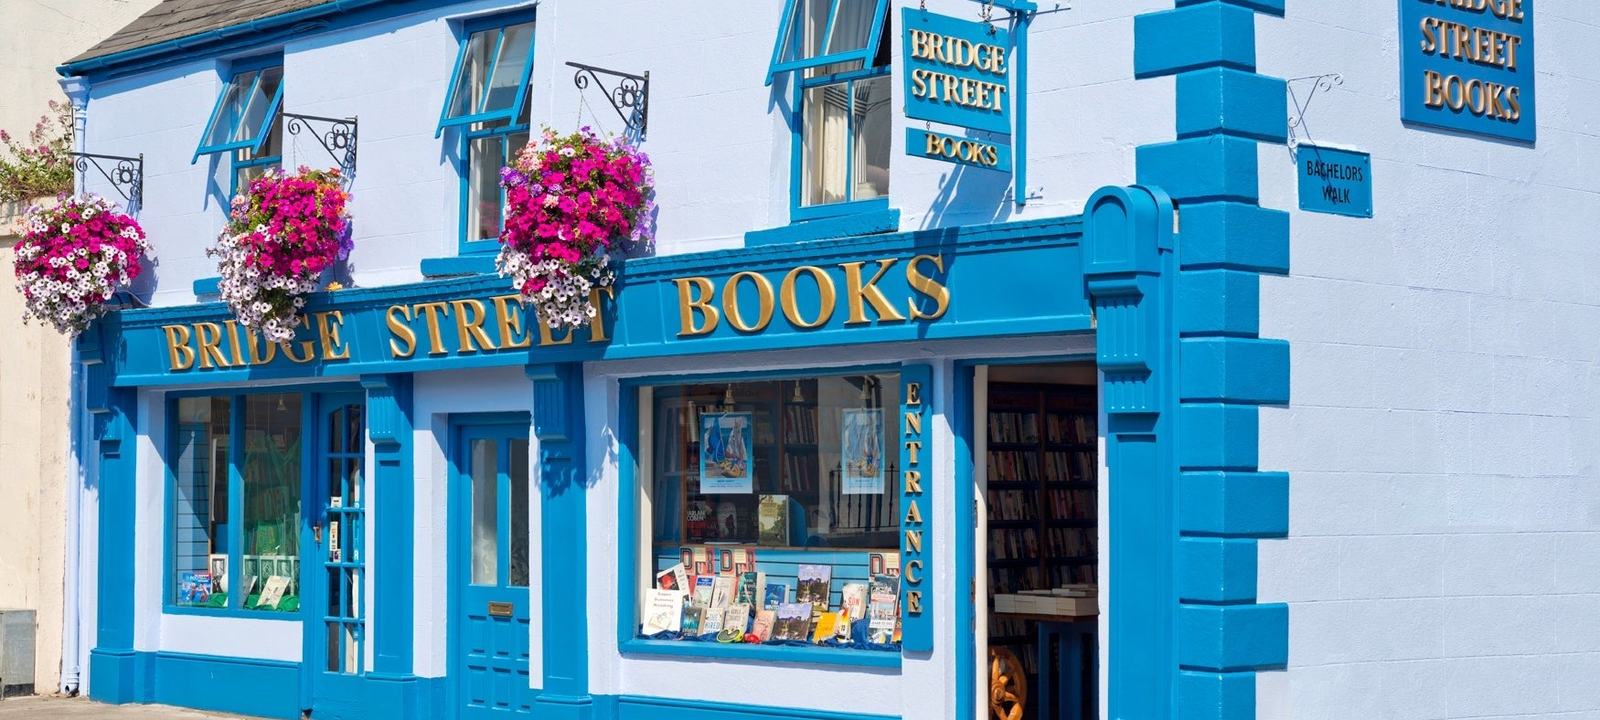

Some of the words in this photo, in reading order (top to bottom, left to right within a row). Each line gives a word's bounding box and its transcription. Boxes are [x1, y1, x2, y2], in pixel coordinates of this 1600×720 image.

[909, 28, 1007, 75] BRIDGE
[1420, 16, 1522, 69] STREET
[911, 68, 1007, 112] STREET
[1424, 69, 1520, 121] BOOKS
[925, 133, 998, 166] BOOKS
[1307, 160, 1363, 182] BACHELORS
[1321, 185, 1351, 204] WALK
[672, 254, 950, 336] BOOKS
[904, 382, 924, 614] ENTRANCE
